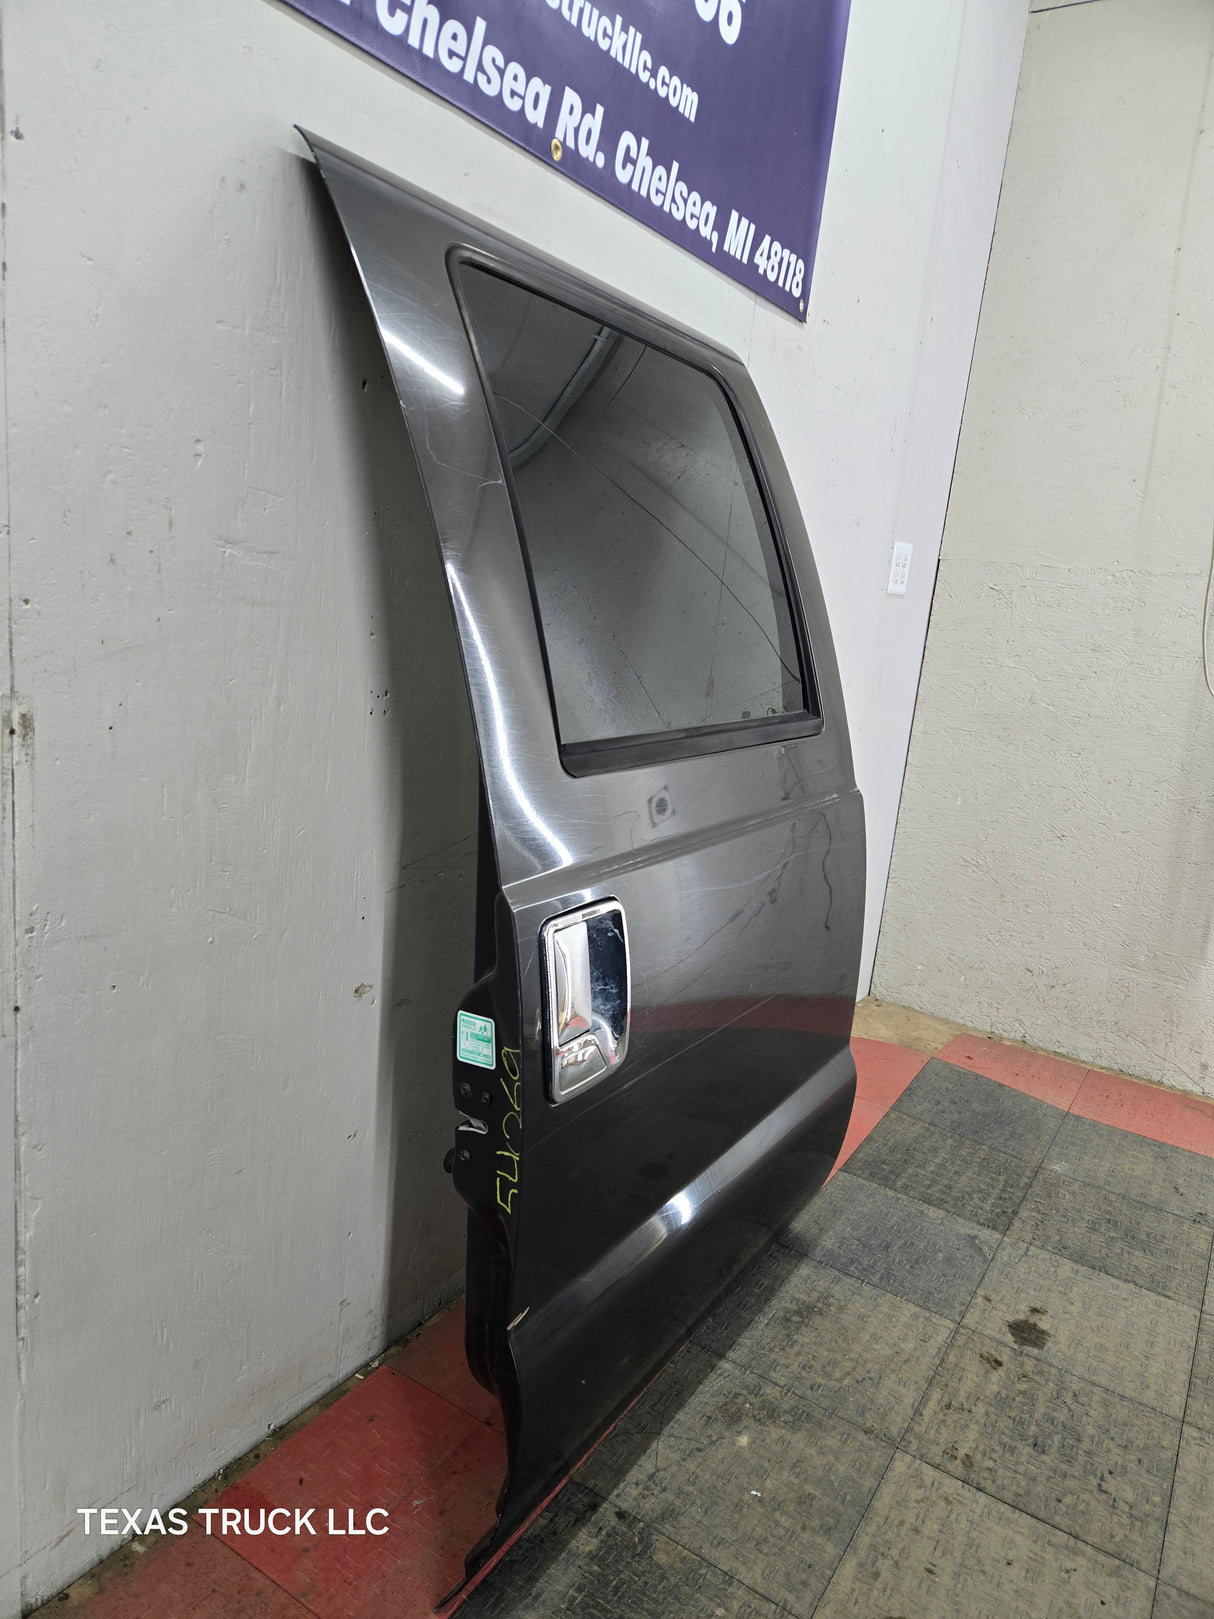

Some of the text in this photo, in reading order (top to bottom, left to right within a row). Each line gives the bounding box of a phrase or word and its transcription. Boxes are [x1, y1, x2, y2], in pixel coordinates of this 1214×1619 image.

[545, 0, 699, 123] truckllc.com
[554, 85, 605, 168] Rd.
[615, 130, 719, 253] Chelsea,
[723, 209, 756, 264] MI
[754, 234, 805, 298] 48118
